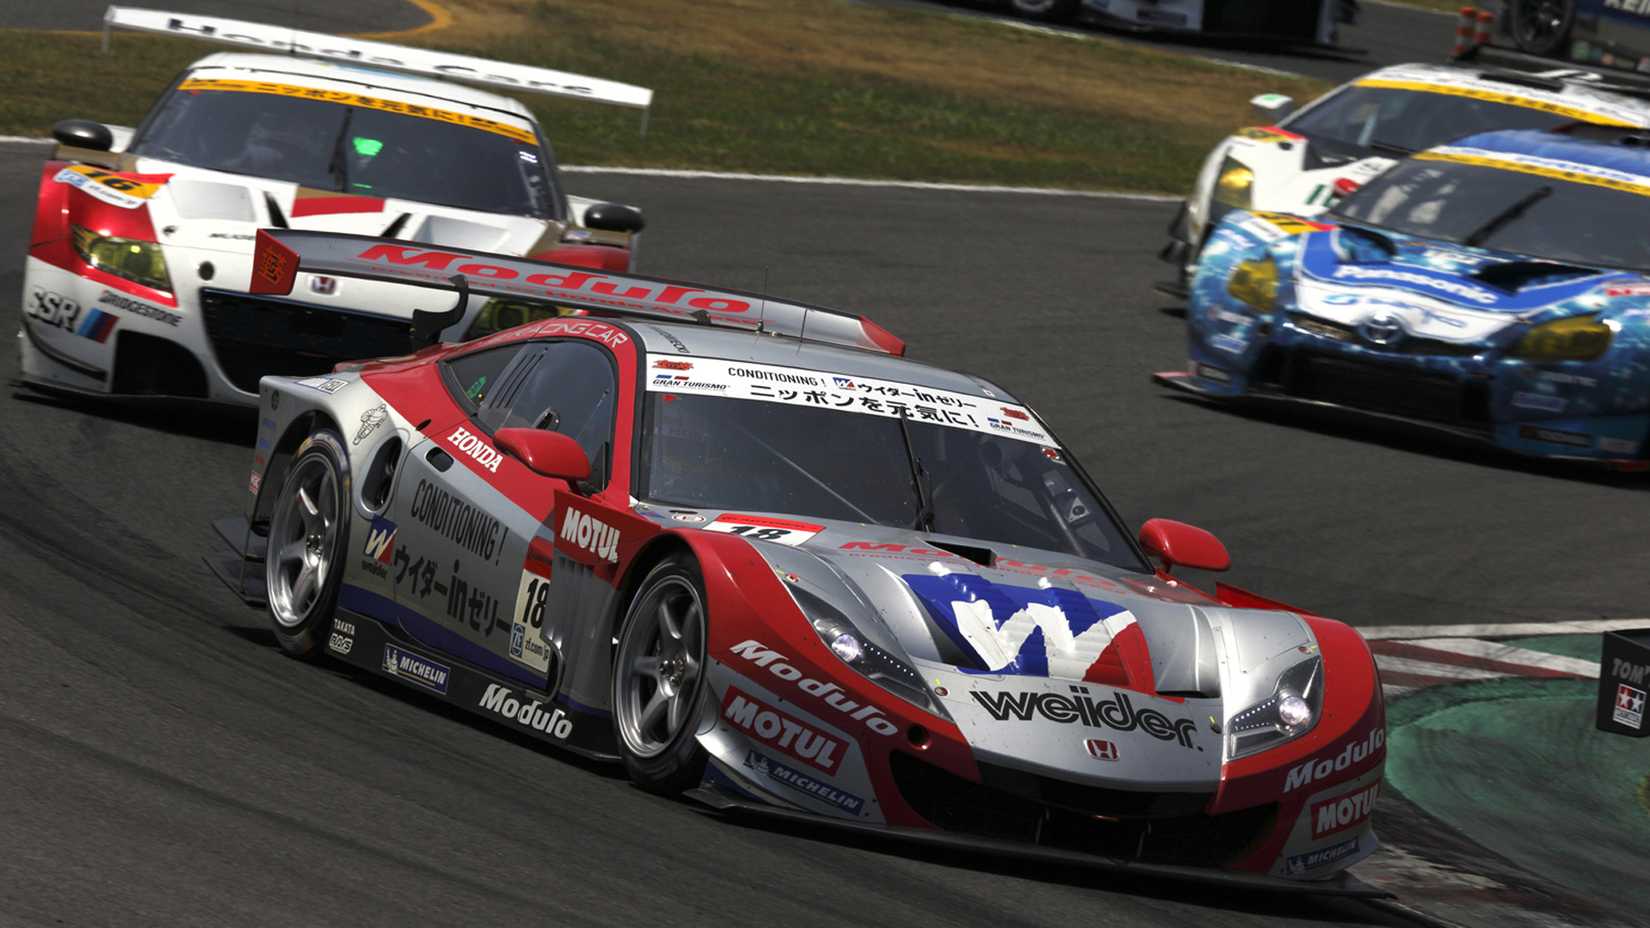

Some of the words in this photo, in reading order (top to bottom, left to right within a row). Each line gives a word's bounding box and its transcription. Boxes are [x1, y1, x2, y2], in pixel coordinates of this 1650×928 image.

[357, 243, 751, 314] Modulo
[652, 378, 680, 387] GRAN
[683, 381, 728, 390] TURISMO
[728, 367, 818, 386] CONDITIONING
[446, 427, 503, 473] HONDA
[411, 478, 501, 561] CONDITIONING
[560, 507, 622, 564] MOTUL
[728, 525, 793, 540] 18
[334, 618, 356, 635] TAKATA
[522, 578, 550, 629] 18
[399, 656, 447, 685] MICHELIN
[729, 639, 898, 737] Modulo
[478, 682, 574, 740] Modulo
[724, 698, 838, 771] MOTUL
[1283, 728, 1385, 793] Modulo
[772, 764, 862, 809] MICHELIN
